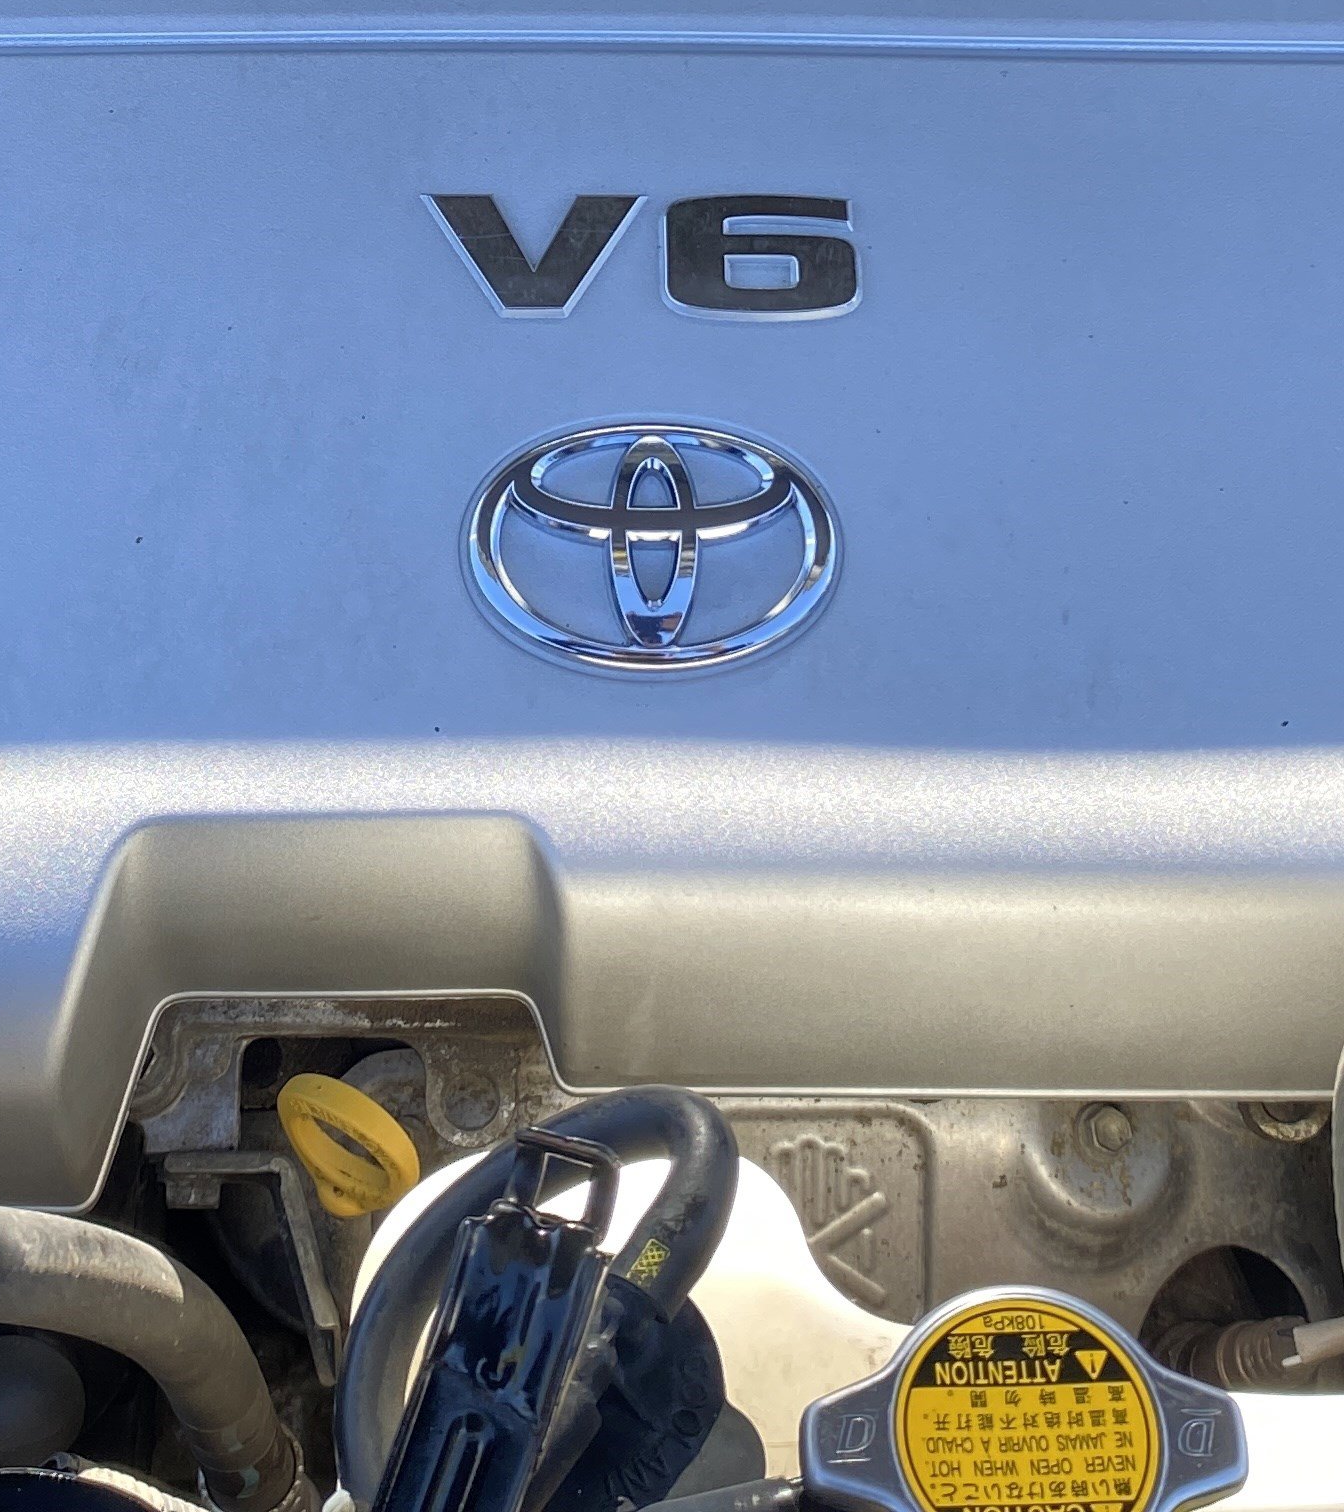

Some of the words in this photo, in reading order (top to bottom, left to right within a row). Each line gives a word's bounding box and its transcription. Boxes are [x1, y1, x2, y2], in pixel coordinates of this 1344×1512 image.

[421, 193, 863, 322] V6
[982, 1314, 1045, 1331] 108kPa
[934, 1359, 1064, 1385] ATTENTION
[998, 1434, 1050, 1453] OUVRIR
[1057, 1432, 1107, 1451] JAMAIS
[1114, 1431, 1134, 1449] NE
[924, 1459, 962, 1477] HOT.
[973, 1459, 1018, 1477] WHEN
[1029, 1457, 1073, 1476] OPEN
[1084, 1454, 1137, 1473] NEVER
